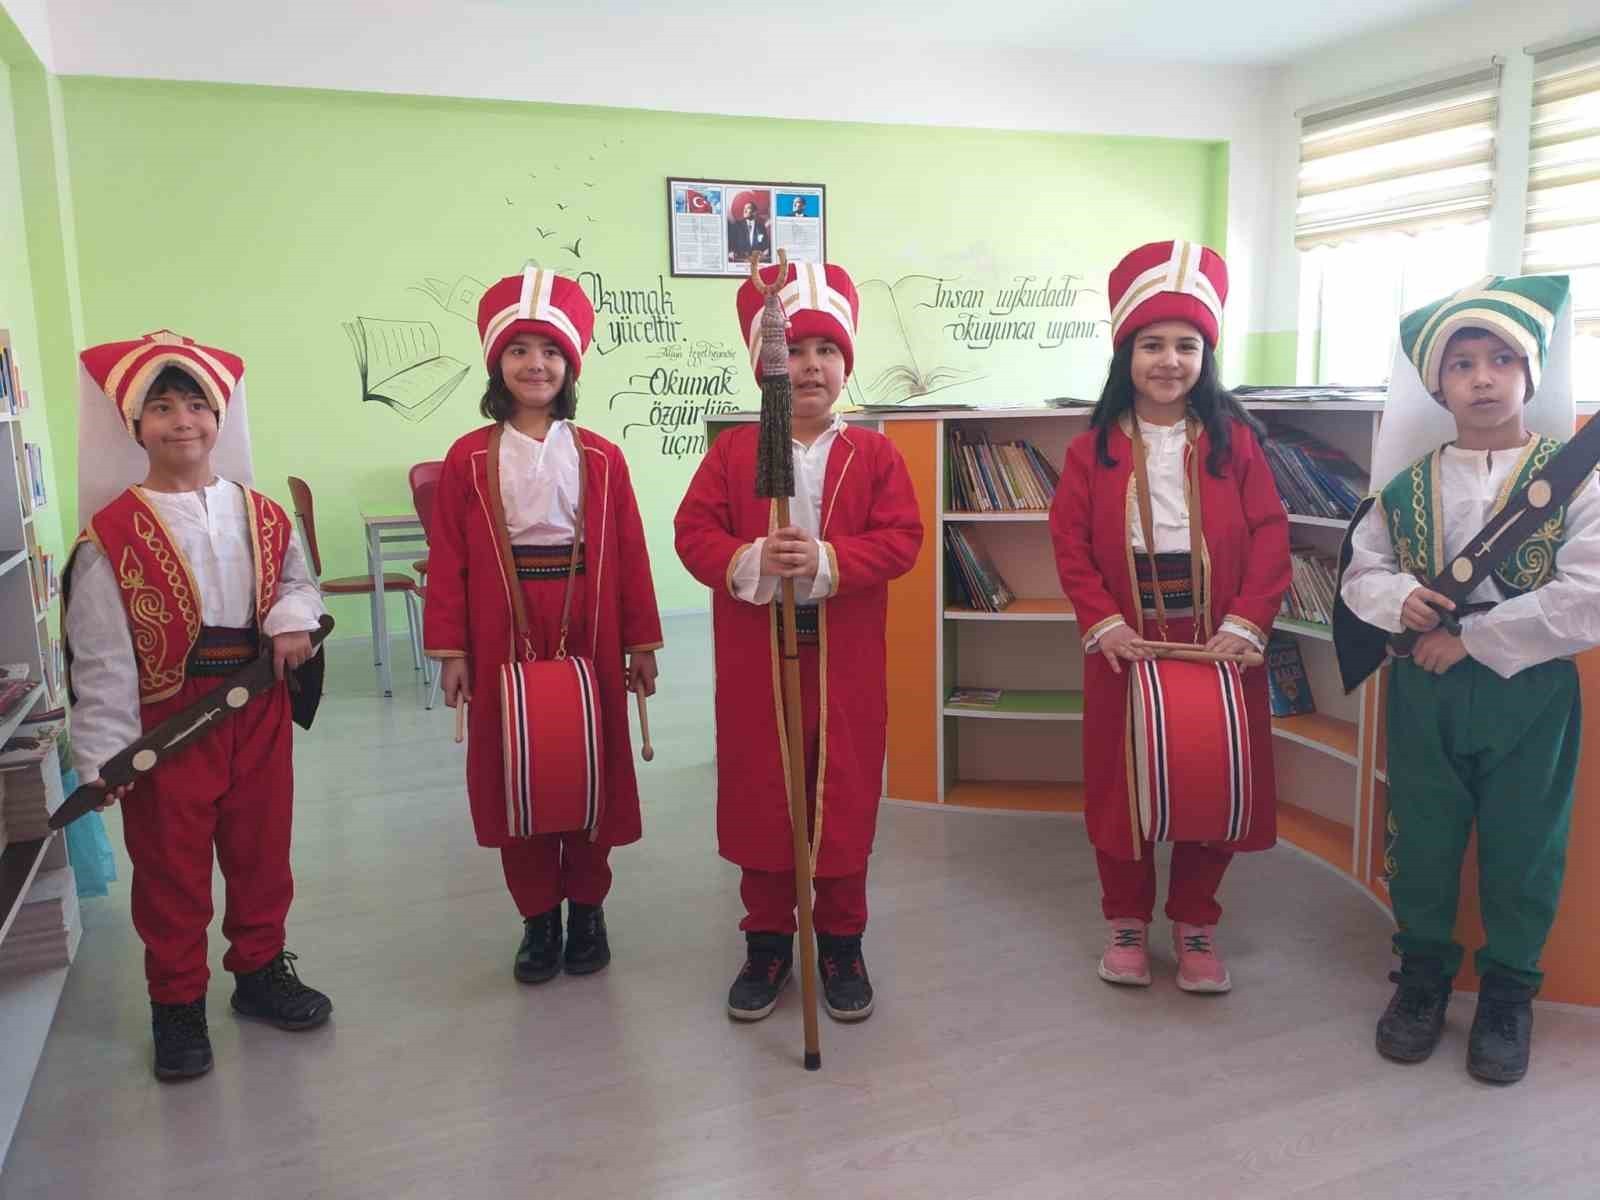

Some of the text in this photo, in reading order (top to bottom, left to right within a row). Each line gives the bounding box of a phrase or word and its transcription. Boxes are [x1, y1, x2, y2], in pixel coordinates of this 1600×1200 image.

[577, 271, 675, 315] Okumak
[597, 315, 687, 355] yüceltir.
[944, 313, 1036, 350] okuyunca
[649, 367, 738, 395] Okumak
[661, 434, 706, 459] uçm
